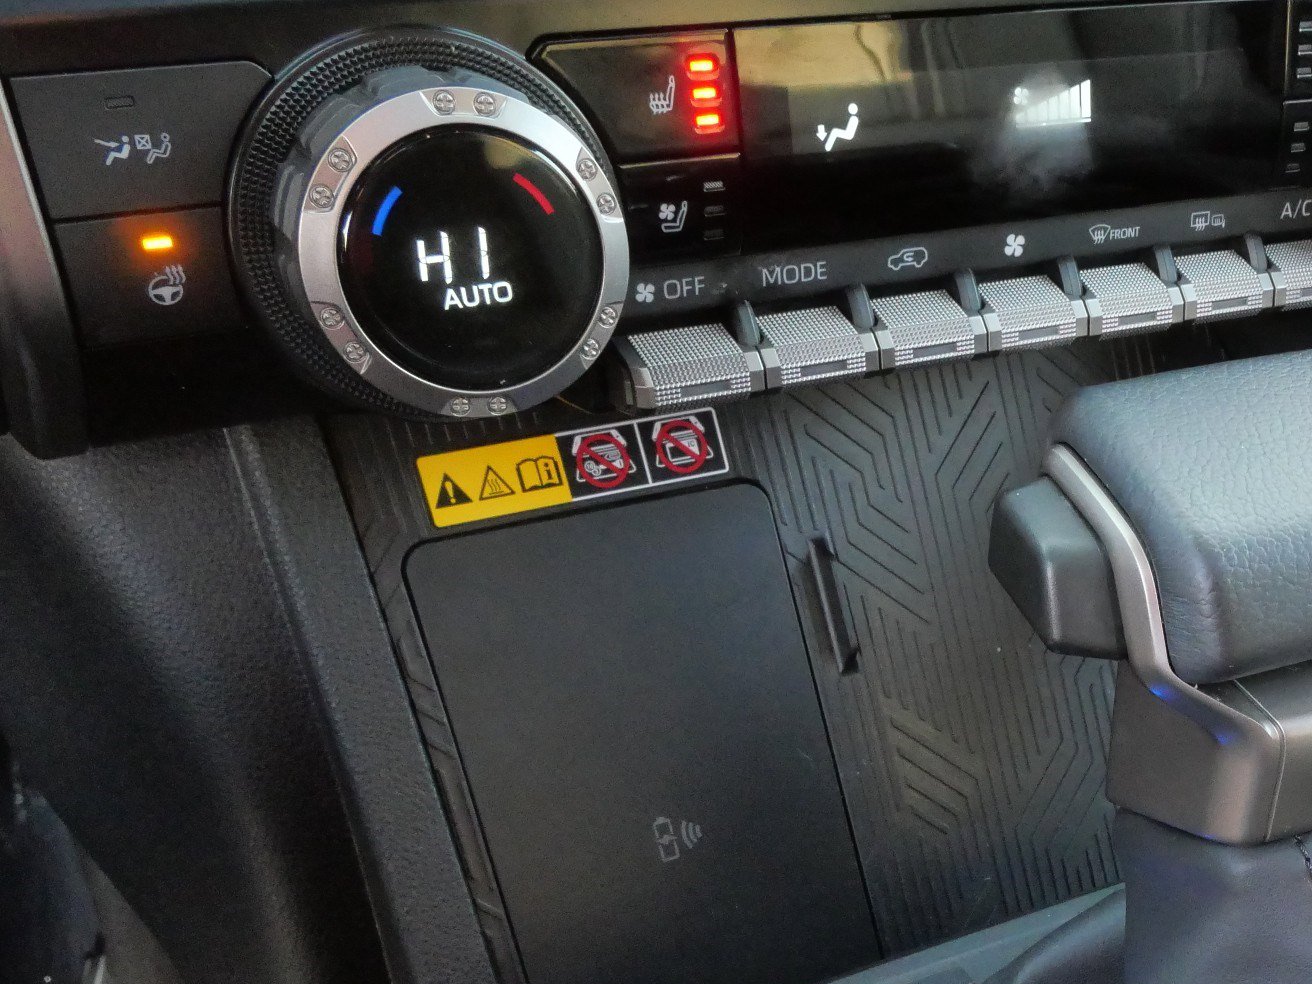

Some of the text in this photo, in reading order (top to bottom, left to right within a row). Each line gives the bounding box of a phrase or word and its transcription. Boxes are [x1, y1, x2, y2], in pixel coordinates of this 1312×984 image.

[1279, 199, 1312, 219] A/C
[1109, 226, 1141, 241] FRONT
[761, 261, 828, 287] MODE
[444, 280, 513, 310] AUTO
[663, 276, 705, 300] OFF
